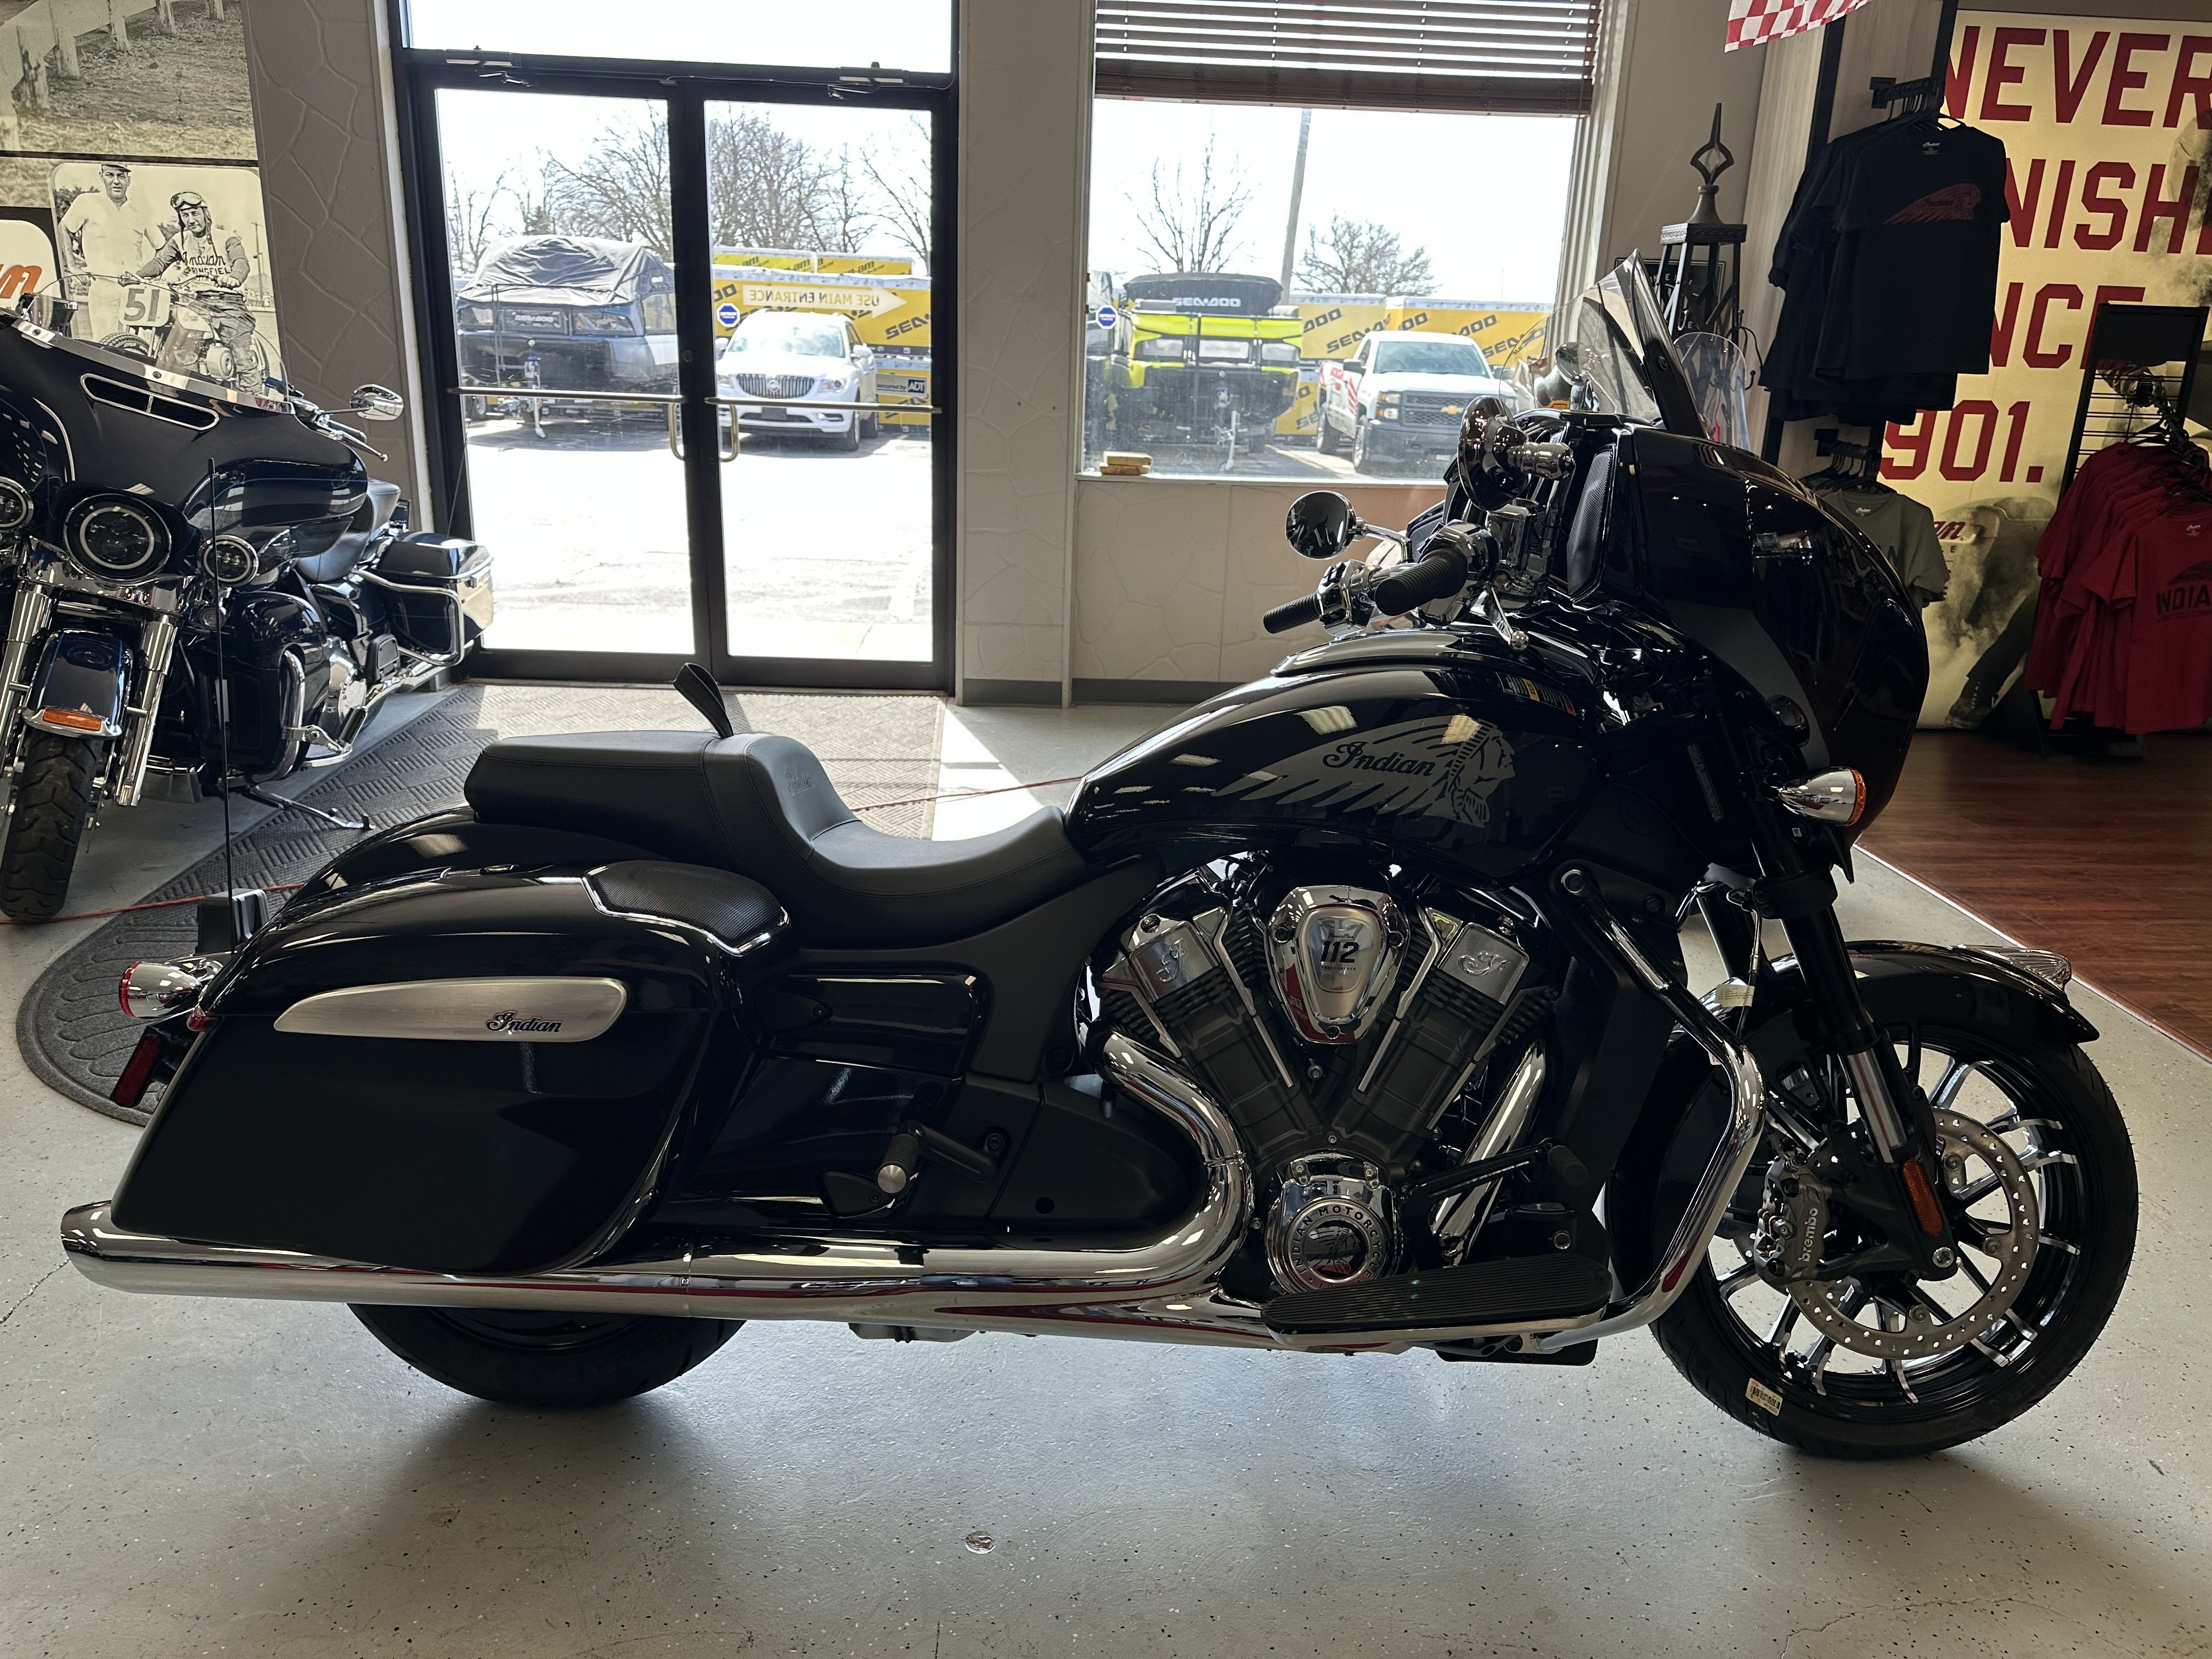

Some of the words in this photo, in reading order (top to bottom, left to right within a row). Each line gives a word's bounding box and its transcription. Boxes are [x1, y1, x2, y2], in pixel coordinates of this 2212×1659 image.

[123, 288, 160, 322] 51
[908, 381, 924, 392] ADT
[1322, 741, 1436, 777] Indian
[1321, 941, 1359, 963] 112
[486, 1011, 562, 1034] Indian
[1291, 1215, 1314, 1275] INDIAN
[1318, 1205, 1384, 1280] MOTORCYCLE
[1798, 1207, 1818, 1263] brembo
